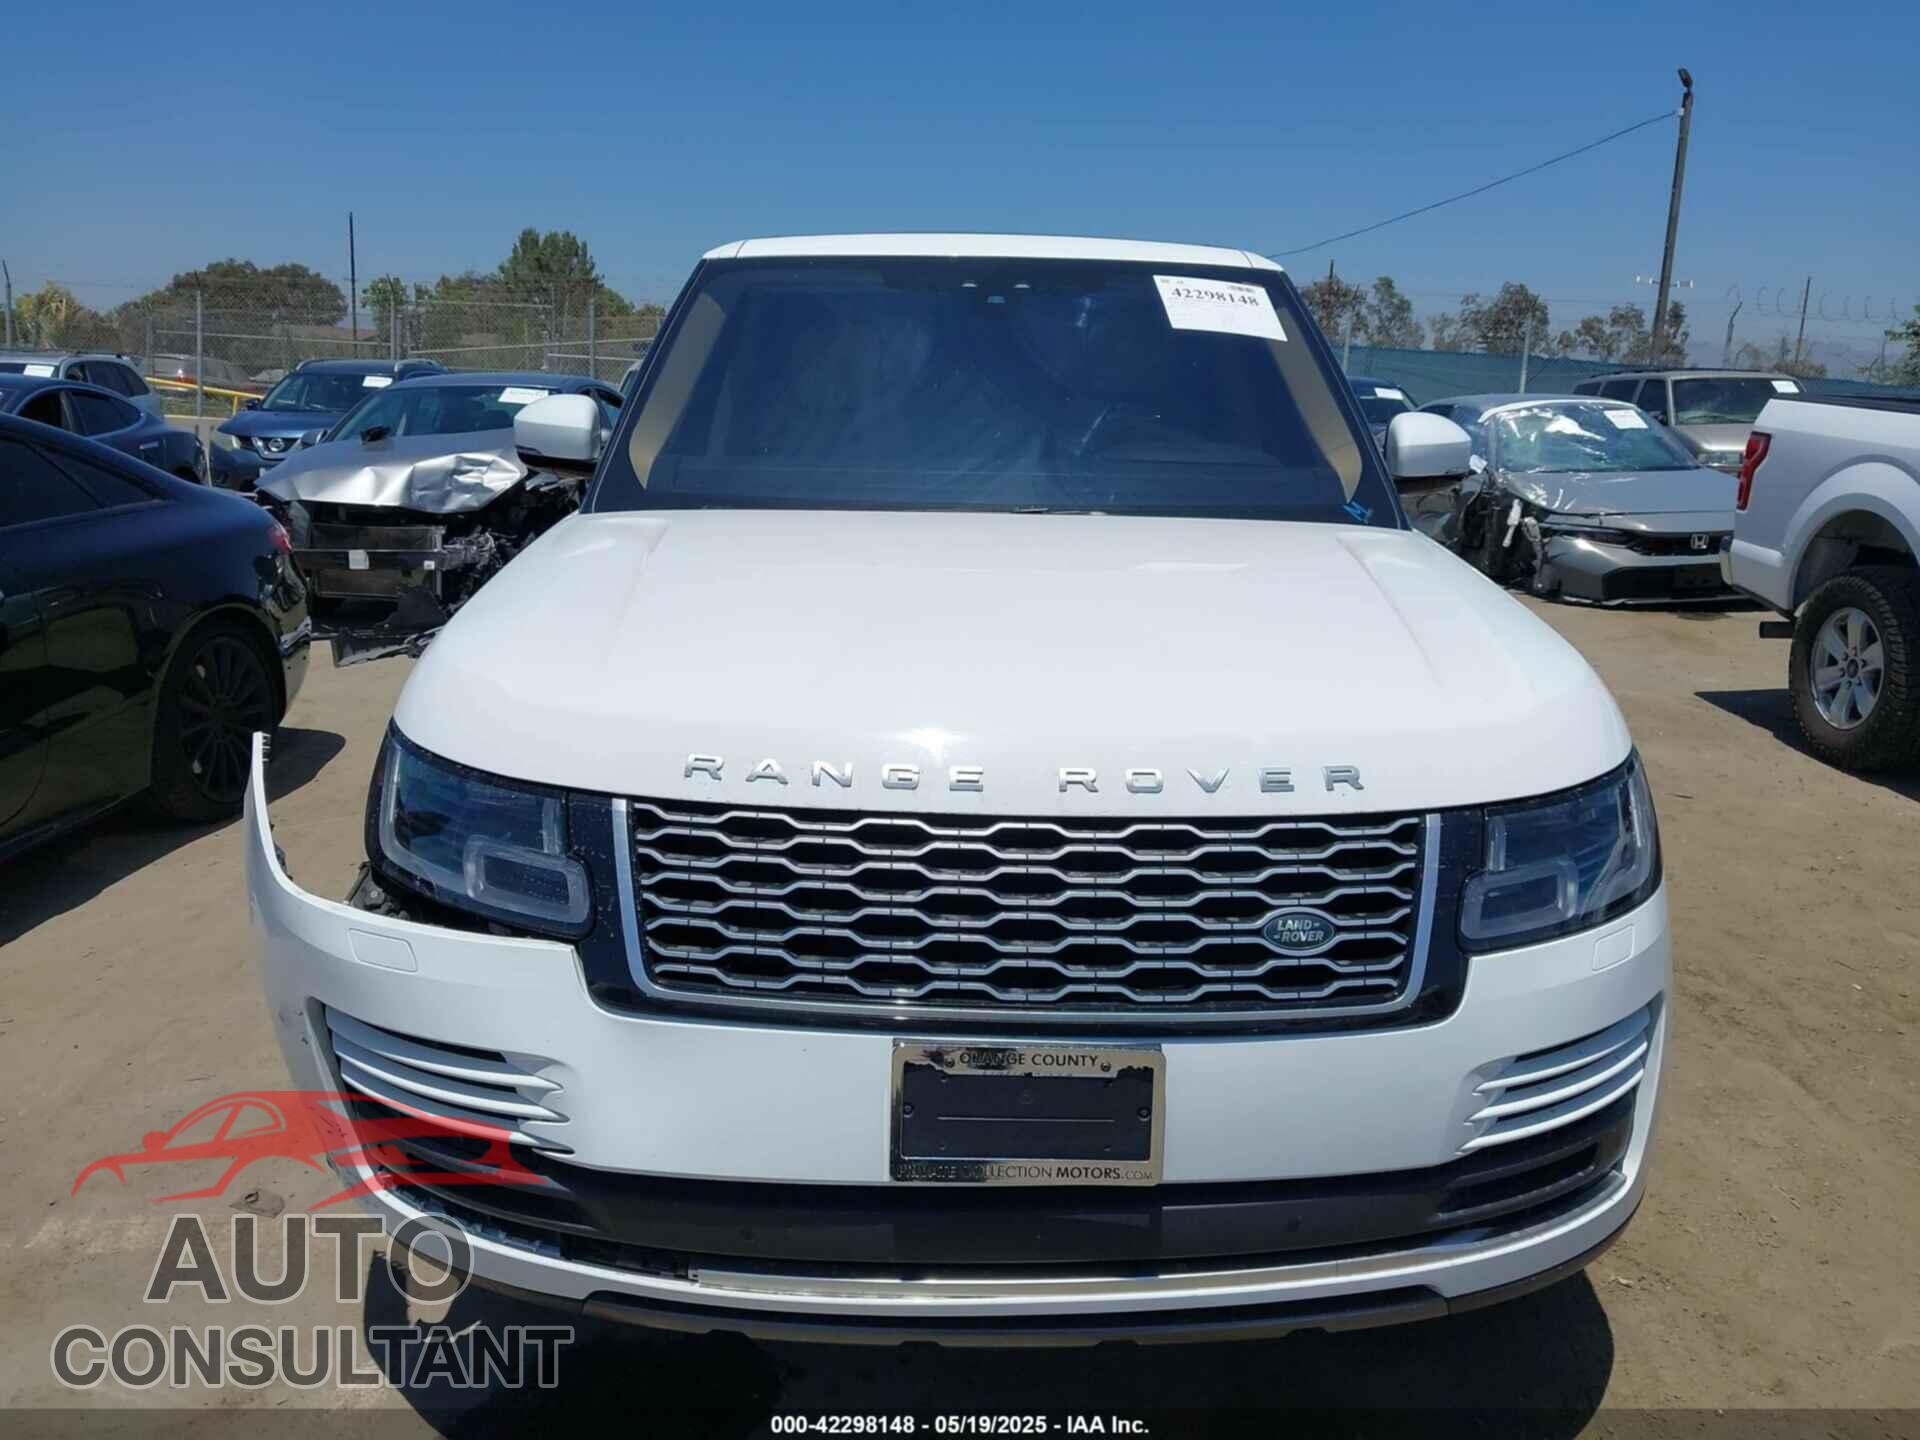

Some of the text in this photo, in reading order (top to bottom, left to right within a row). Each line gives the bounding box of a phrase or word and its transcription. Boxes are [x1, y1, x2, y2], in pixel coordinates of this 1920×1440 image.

[1171, 287, 1260, 307] 42298148
[684, 753, 1365, 793] RANGE ROVER
[1031, 1053, 1098, 1067] COUNTY
